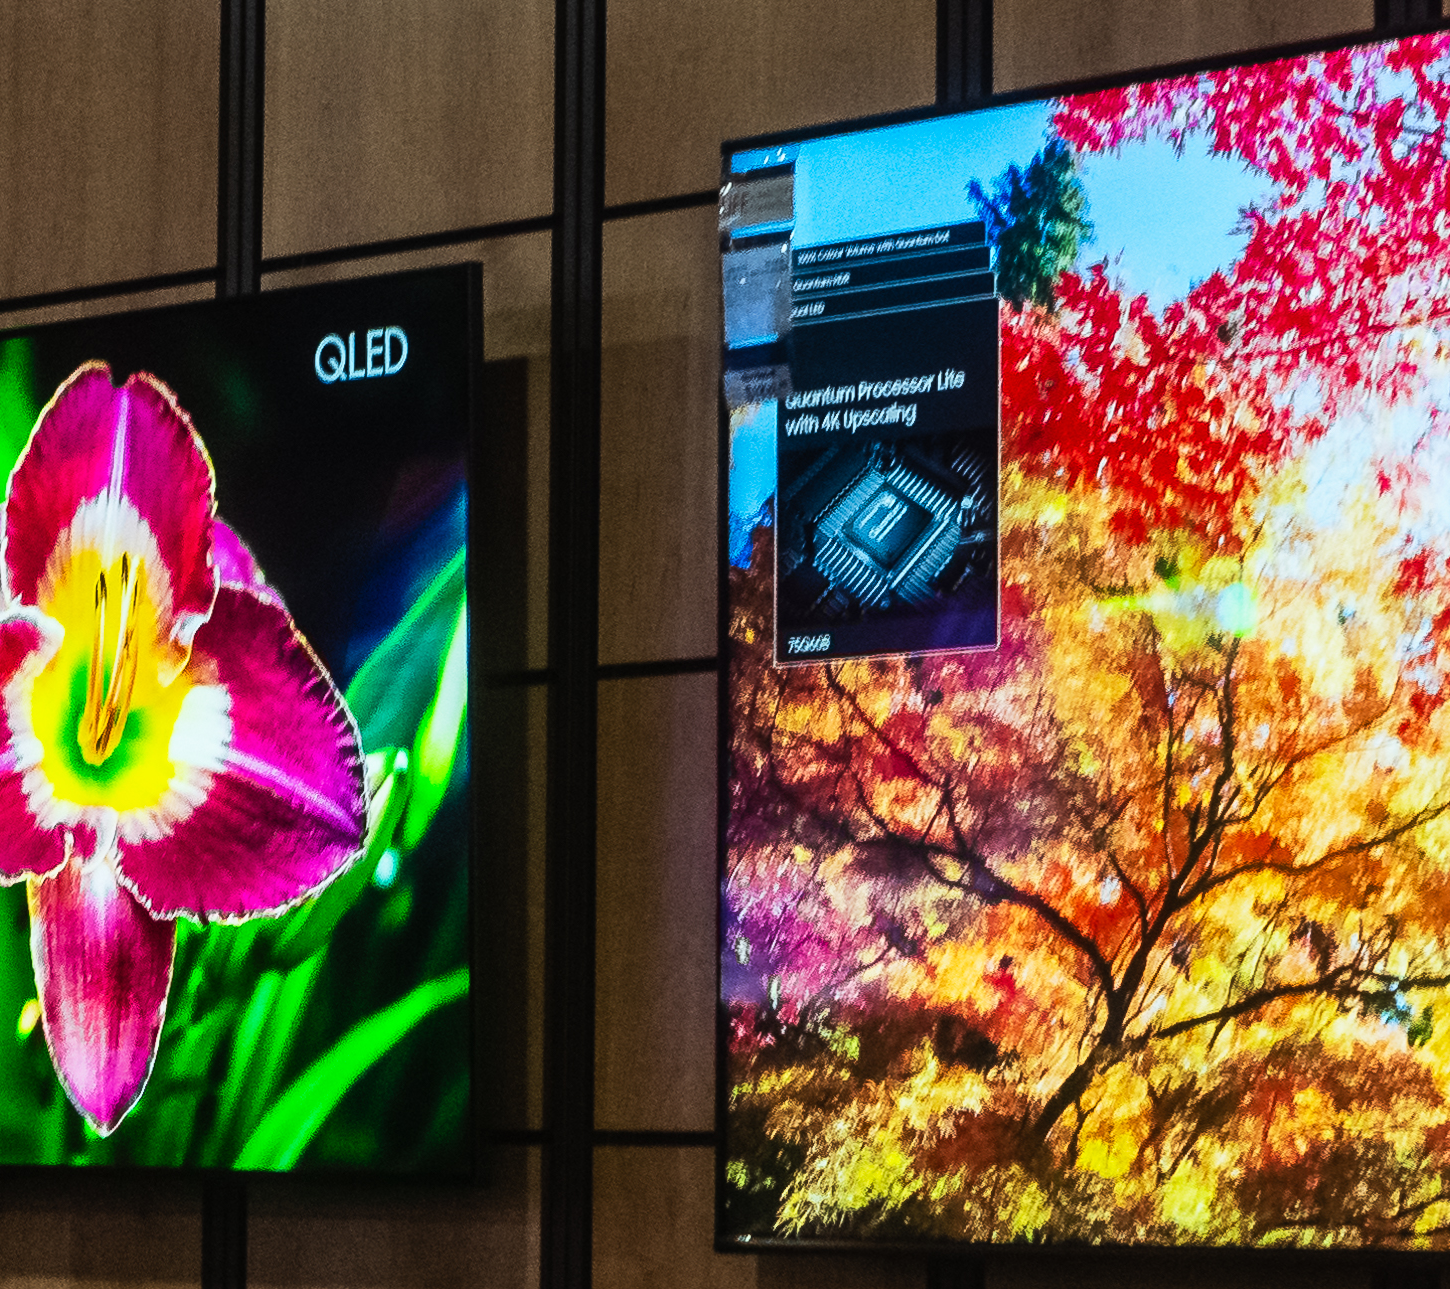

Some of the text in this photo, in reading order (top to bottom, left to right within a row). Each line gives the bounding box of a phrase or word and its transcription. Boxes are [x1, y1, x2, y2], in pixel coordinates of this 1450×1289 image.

[793, 276, 831, 292] Quantum
[314, 326, 408, 384] QLED
[785, 367, 966, 410] Quantum Processor Lite
[785, 401, 917, 437] with 4K Upscaling
